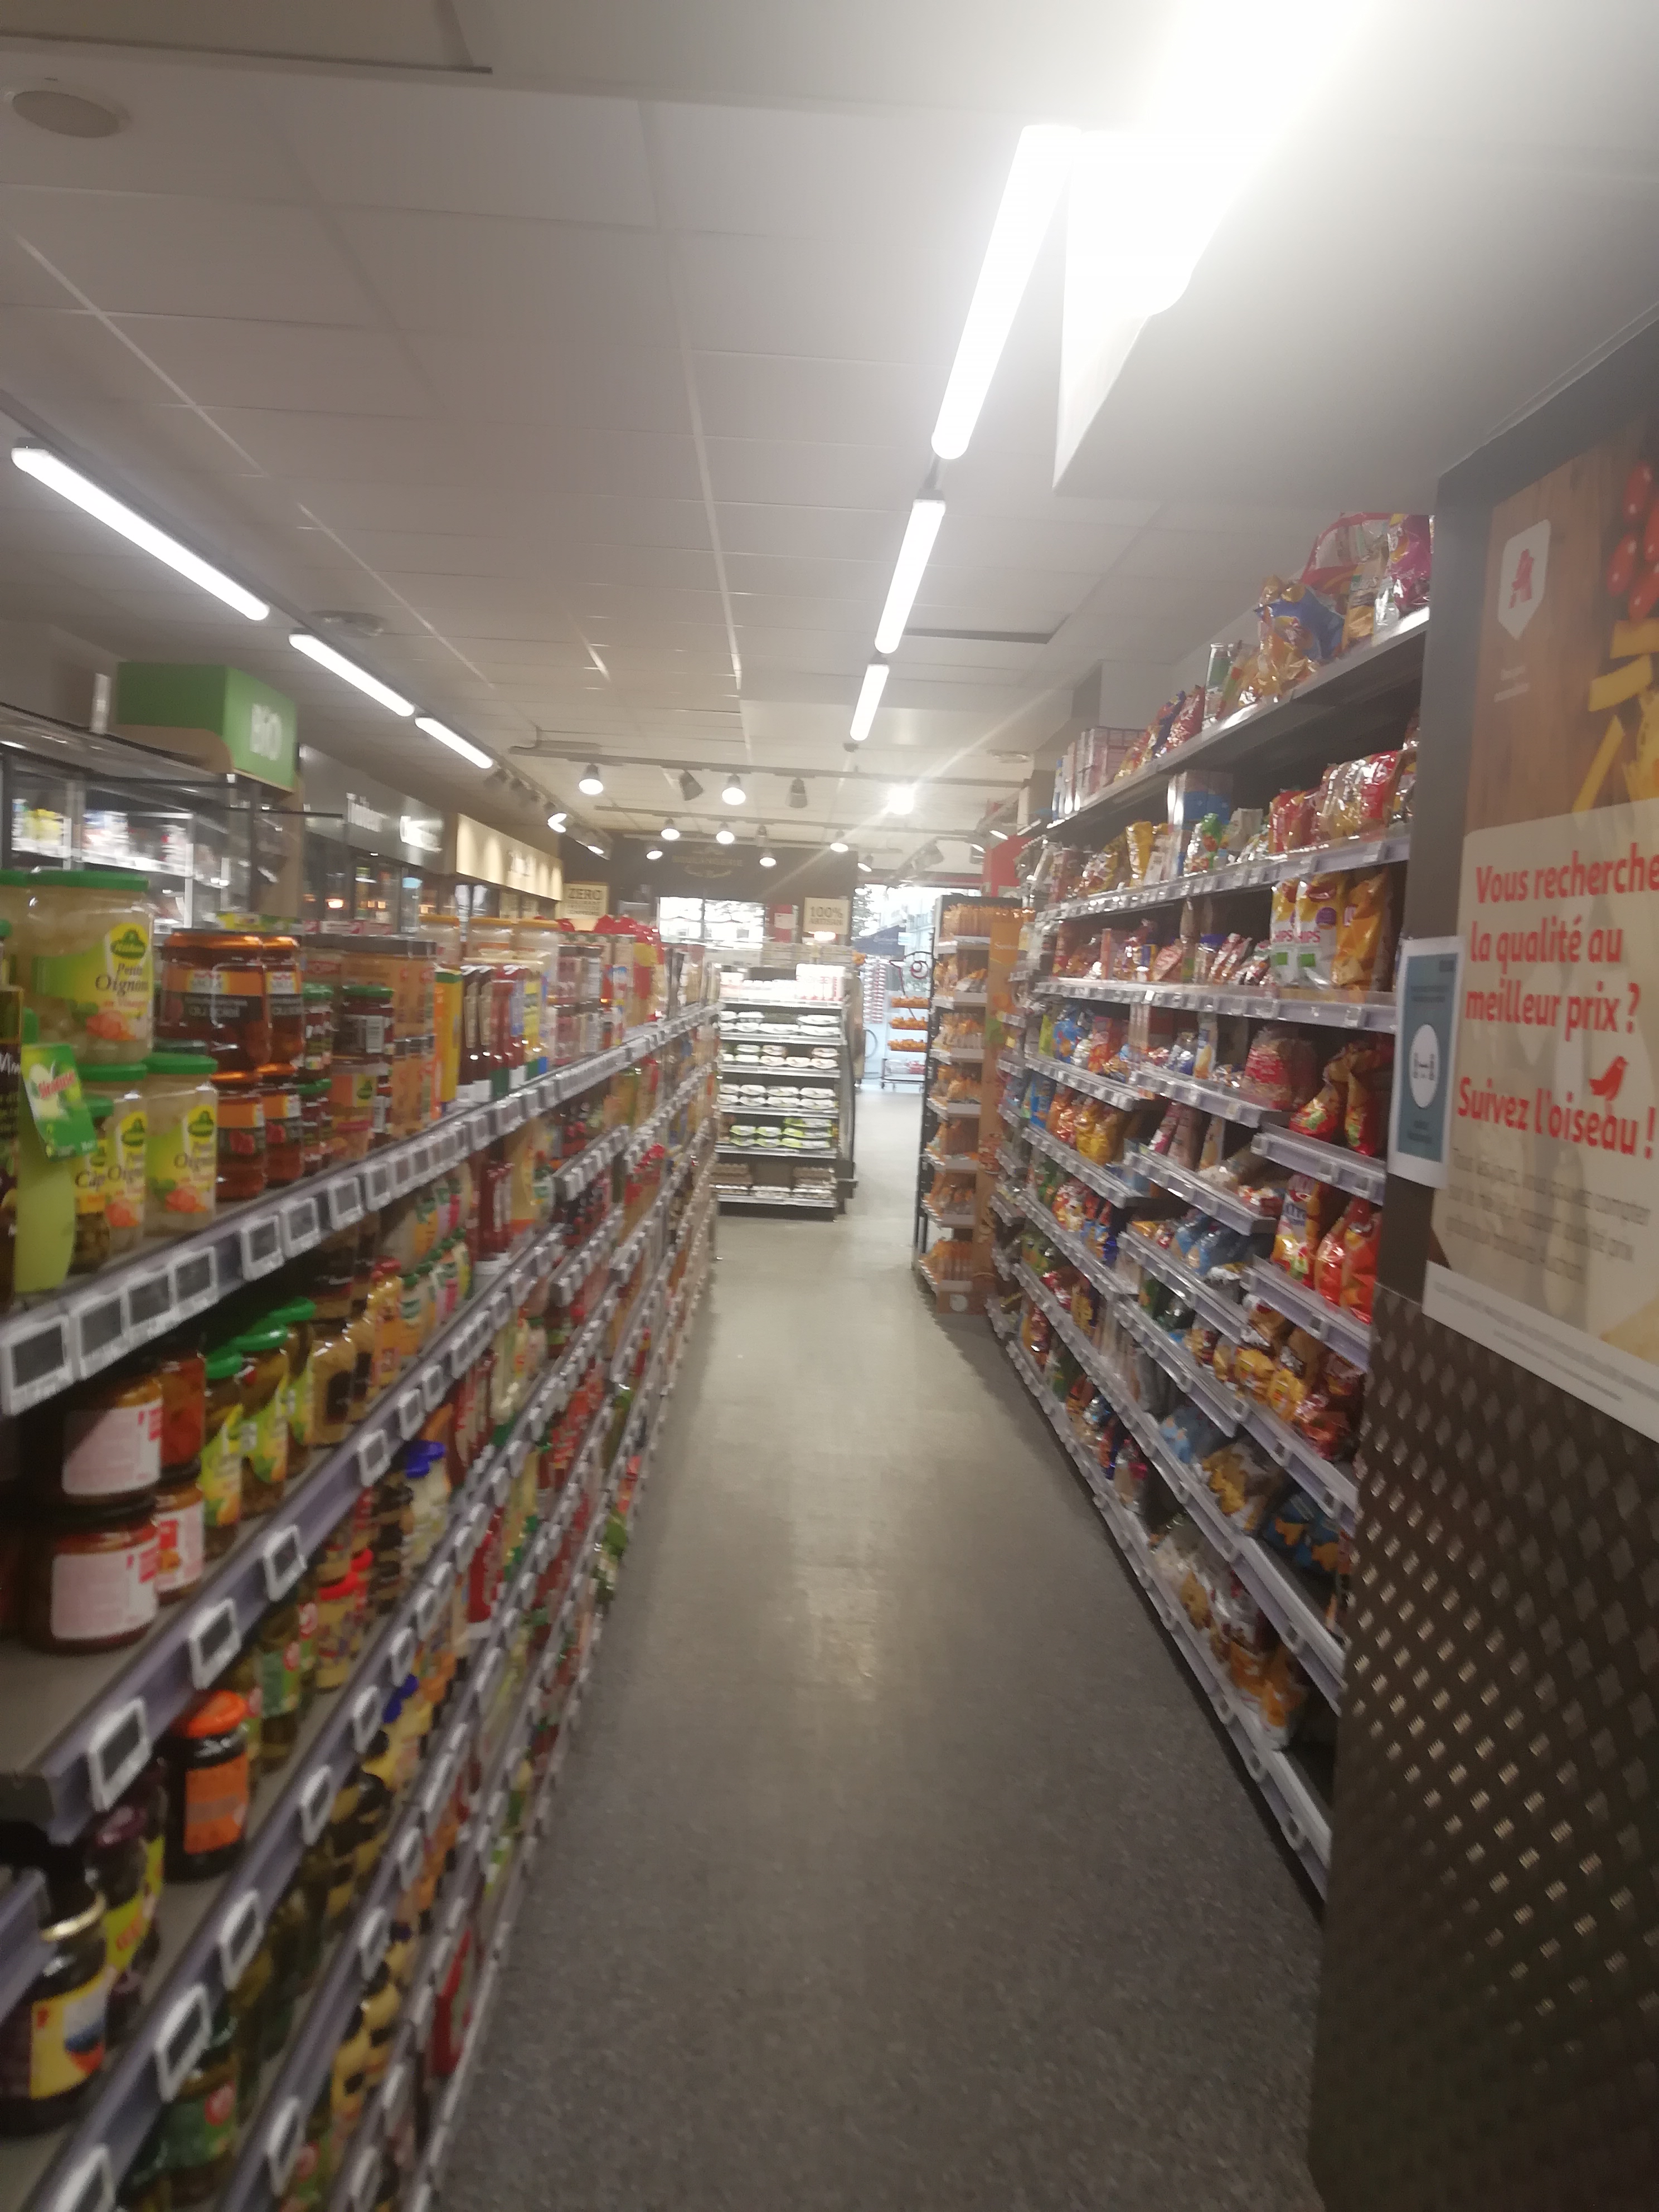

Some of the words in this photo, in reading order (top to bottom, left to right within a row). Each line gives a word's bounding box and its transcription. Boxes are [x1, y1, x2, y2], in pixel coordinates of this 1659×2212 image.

[810, 906, 843, 919] 100%
[1476, 866, 1529, 904] Vous
[1471, 920, 1492, 963] la
[1496, 914, 1582, 974] qualité
[1588, 929, 1623, 963] au
[1465, 977, 1560, 1027] meilleur
[1565, 980, 1620, 1042] prix
[1458, 1076, 1530, 1131] Suivez
[1535, 1087, 1638, 1157] l'oiseau
